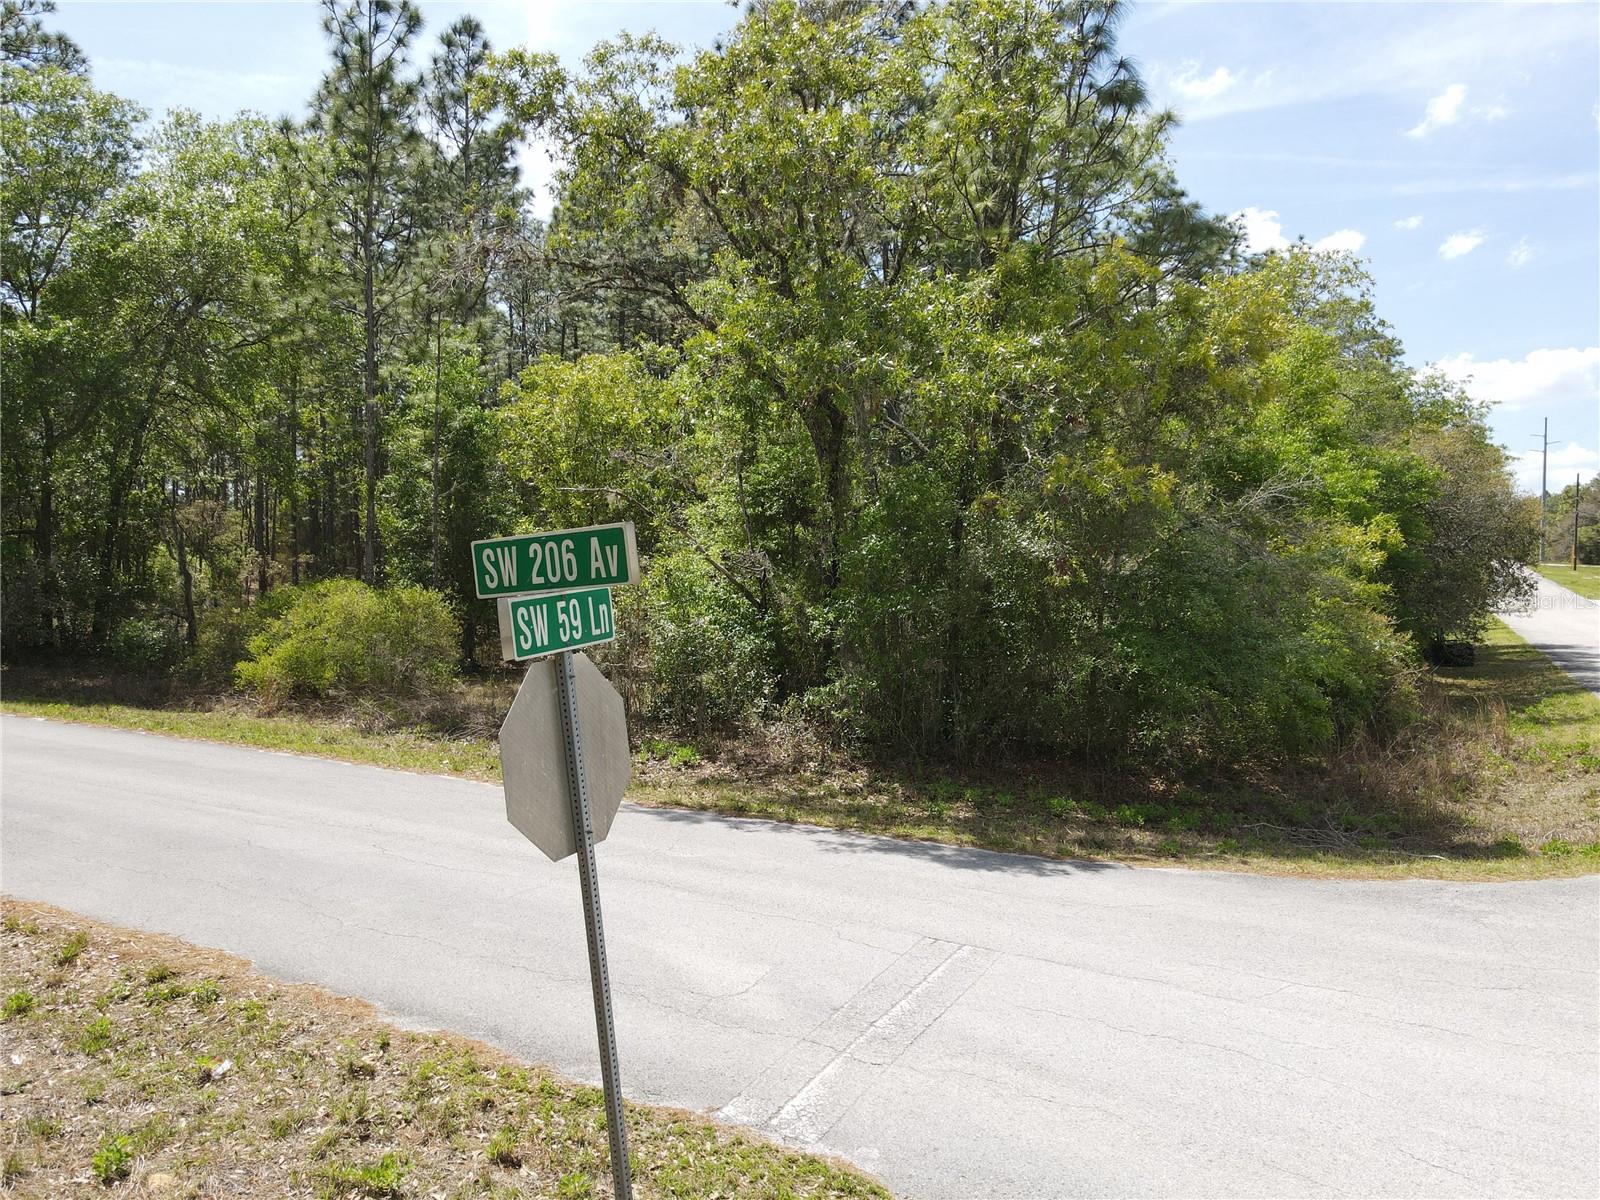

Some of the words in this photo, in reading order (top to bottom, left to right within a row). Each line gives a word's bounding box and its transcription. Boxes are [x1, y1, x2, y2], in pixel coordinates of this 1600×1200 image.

[482, 546, 517, 588] SW
[528, 539, 578, 584] 206
[590, 537, 618, 579] Av
[517, 604, 549, 650] SW
[556, 598, 583, 642] 59
[588, 597, 610, 636] Ln
